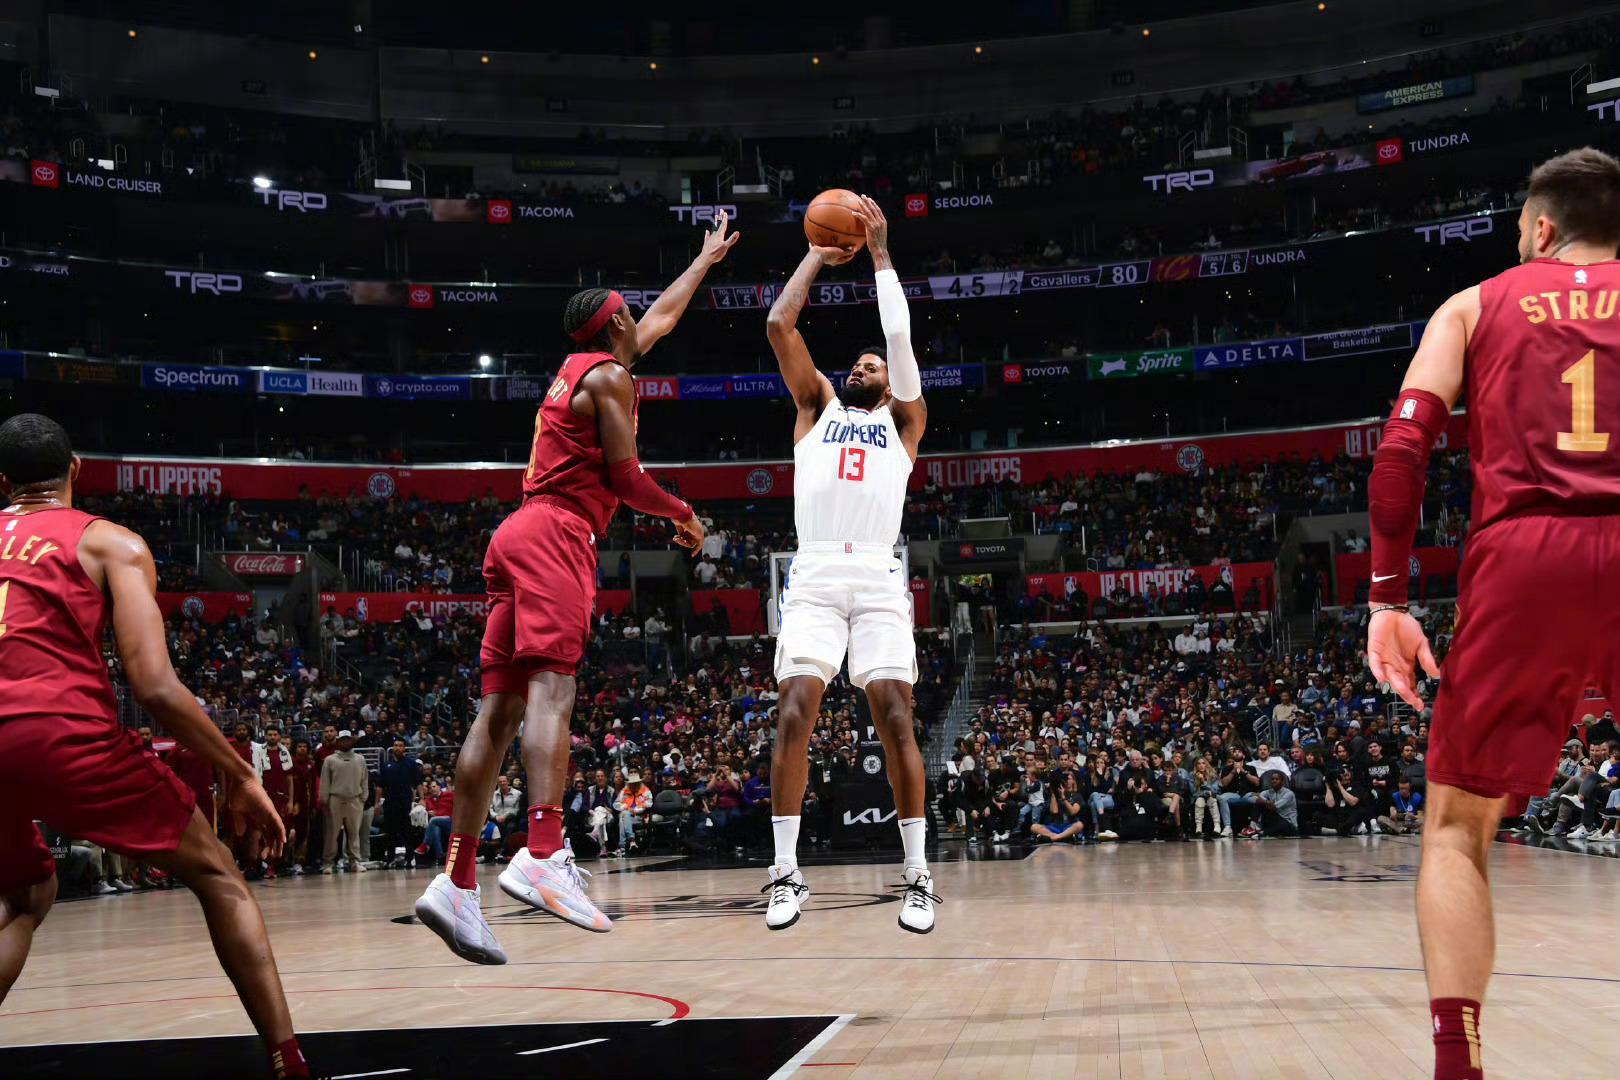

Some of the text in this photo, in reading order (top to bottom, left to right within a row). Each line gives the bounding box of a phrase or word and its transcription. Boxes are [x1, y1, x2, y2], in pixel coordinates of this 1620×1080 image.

[1384, 80, 1442, 99] AMERICAN
[1392, 89, 1444, 106] EXPRESS
[1409, 132, 1471, 153] TUNDRA
[67, 171, 162, 193] LAND CRUISER
[1142, 168, 1215, 194] TRD
[254, 188, 328, 213] TRD
[934, 194, 994, 209] SEQUOIA
[518, 206, 575, 219] TACOMA
[668, 205, 737, 226] TRD
[1414, 217, 1493, 245] TRD
[1112, 265, 1137, 284] 80
[1232, 260, 1241, 272] 6
[164, 269, 243, 296] TRD
[947, 276, 986, 297] 4.5
[1008, 279, 1018, 294] 2
[1030, 272, 1090, 288] Cavaliers
[440, 290, 498, 303] TACOMA
[722, 294, 751, 306] 4 5
[820, 286, 844, 304] 59
[1519, 290, 1620, 324] STRU
[1136, 352, 1182, 372] Sprite
[1225, 344, 1294, 363] DELTA
[154, 367, 240, 388] Spectrum
[1025, 366, 1070, 377] TOYOTA
[269, 376, 304, 388] UCLA
[311, 378, 358, 392] Health
[395, 380, 459, 395] crypto.com
[734, 381, 775, 392] ULTRA
[921, 377, 963, 387] XPRESS
[1557, 349, 1610, 452] 1
[822, 420, 888, 449] CLIPPERS
[838, 447, 866, 482] 13
[947, 457, 1021, 487] CLIPPERS
[139, 466, 222, 496] CLIPPERS
[0, 535, 59, 565] LEY
[975, 545, 1006, 554] TOYOTA
[1029, 577, 1044, 585] 107
